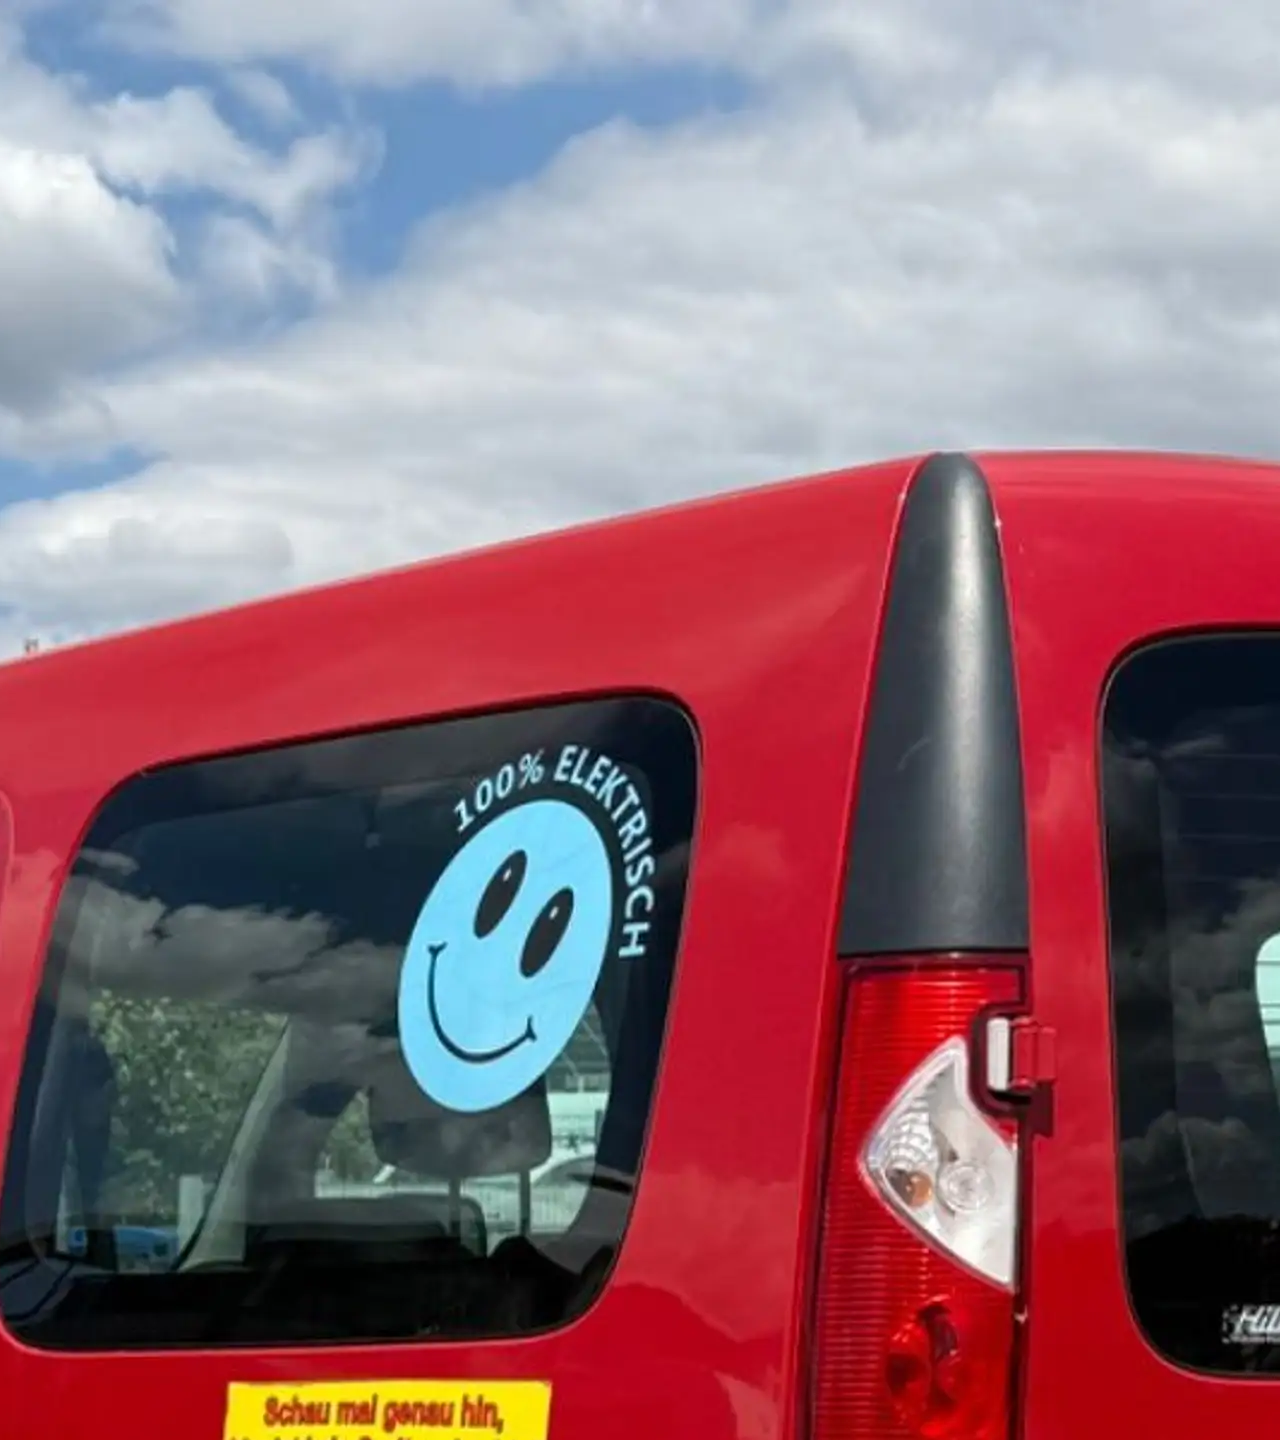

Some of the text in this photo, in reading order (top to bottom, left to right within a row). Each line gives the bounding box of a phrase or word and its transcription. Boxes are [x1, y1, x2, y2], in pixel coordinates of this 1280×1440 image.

[453, 744, 656, 958] 100% ELEKTRISCH
[263, 1392, 504, 1434] Schau mal genau hin,
